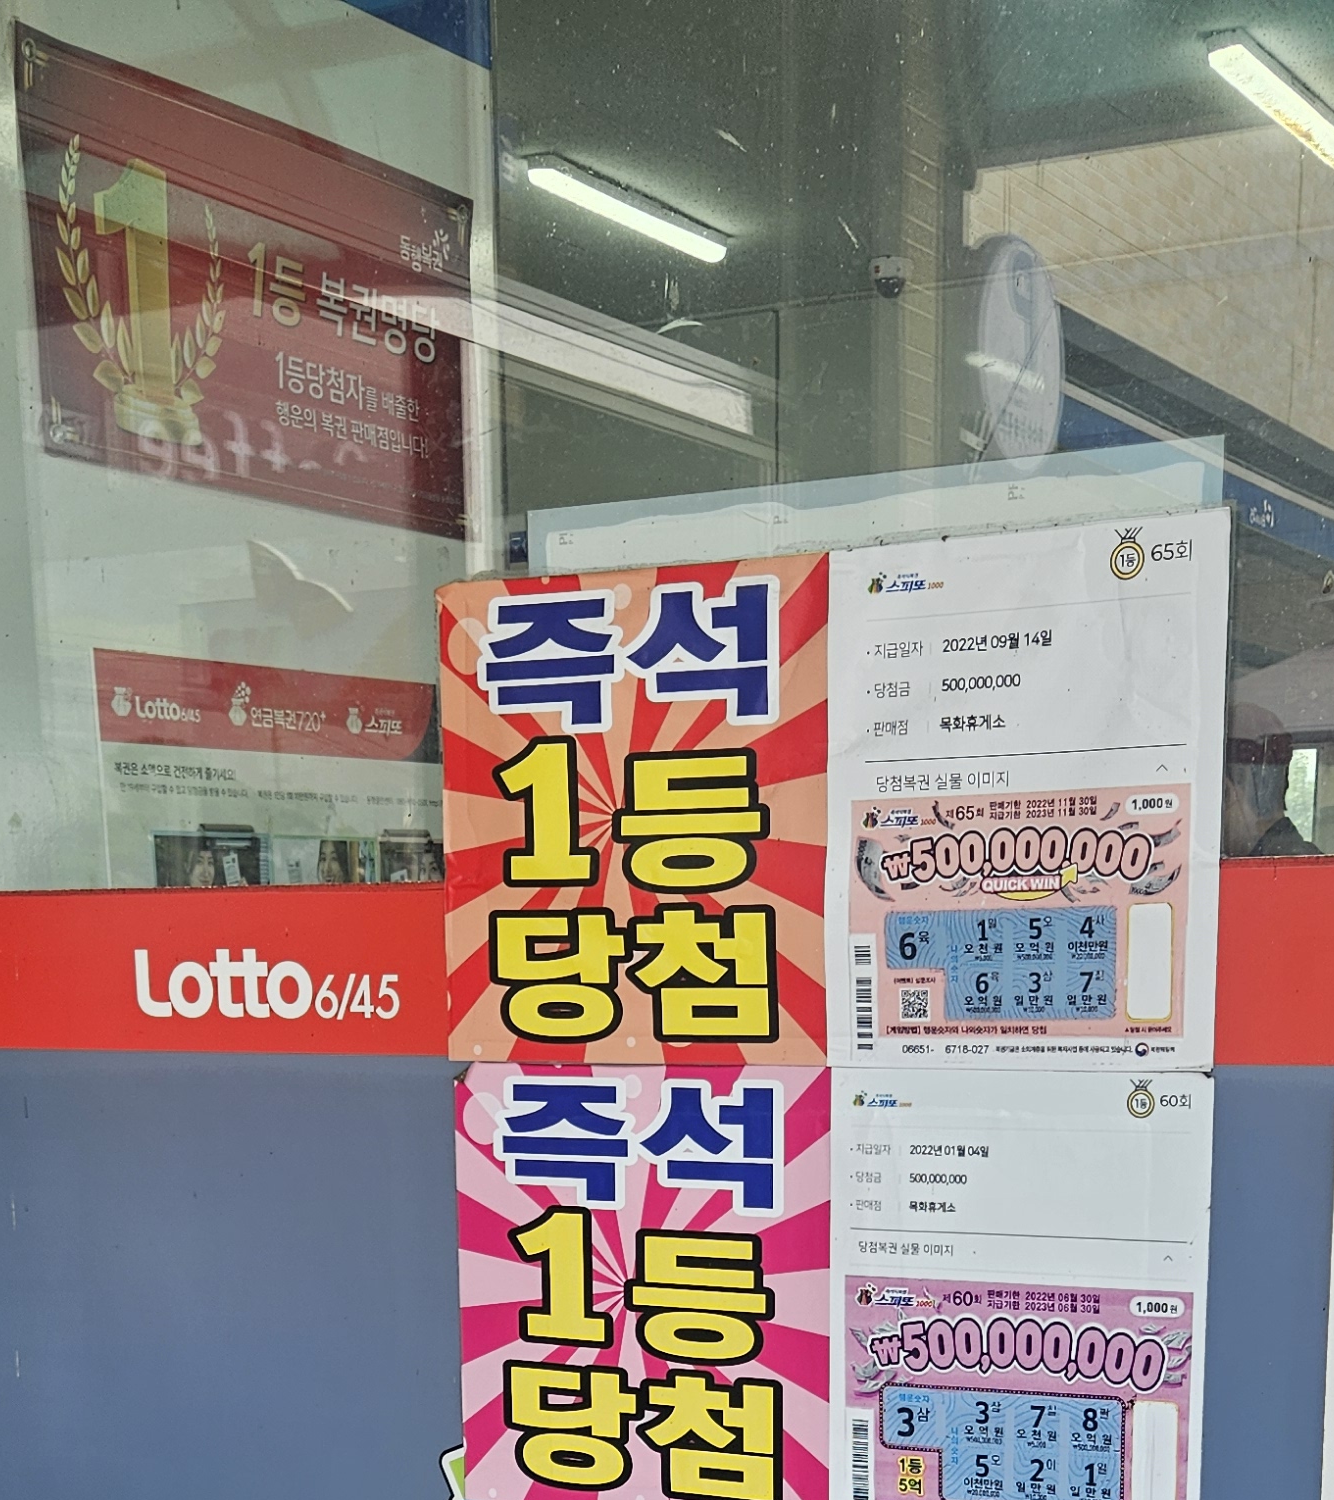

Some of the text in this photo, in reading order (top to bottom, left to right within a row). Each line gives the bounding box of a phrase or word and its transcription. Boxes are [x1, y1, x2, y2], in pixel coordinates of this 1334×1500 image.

[247, 241, 440, 363] 1등 복권명당
[275, 351, 419, 422] 1등당첨자를 배출한
[275, 400, 317, 433] 행운의
[321, 411, 348, 440] 복권
[1120, 539, 1192, 567] 1등 65회
[482, 579, 772, 729] 즉석
[874, 629, 1053, 659] 지급일자 2022년 09월 14일
[874, 673, 1021, 698] 당첨금 500,000,000
[873, 714, 1006, 737] 판매점 목화휴게소
[876, 771, 1009, 793] 당첨복권 실물 이미지
[1026, 799, 1055, 809] 2022년
[1058, 797, 1076, 808] 11월
[1079, 796, 1097, 806] 30일
[1026, 809, 1055, 819] 2023년
[1058, 807, 1076, 818] 11월
[1079, 806, 1097, 816] 30일
[493, 736, 770, 894] 1등
[980, 875, 1062, 893] QUICK WIN
[977, 919, 988, 941] 1
[1029, 918, 1042, 939] 5
[1080, 916, 1094, 938] 4
[899, 932, 917, 960] 6
[489, 902, 779, 1044] 당첨
[976, 971, 1094, 994] 6 3 7
[945, 1045, 989, 1054] 6718-027
[1160, 1094, 1191, 1109] 60회
[500, 1081, 776, 1212] 즉석
[856, 1143, 989, 1158] 지급일자 2022년 01월 04일
[909, 1173, 967, 1185] 500,000,000
[909, 1201, 956, 1213] 목화휴게소
[858, 1241, 898, 1254] 당첨복권
[923, 1244, 954, 1257] 이미지
[507, 1205, 775, 1366] 1등
[1024, 1301, 1055, 1312] 2023년
[1058, 1303, 1077, 1313] 06월
[1080, 1304, 1100, 1314] 30일
[1025, 1292, 1055, 1302] 2022년
[1058, 1293, 1077, 1303] 06월
[1080, 1294, 1100, 1304] 30일
[897, 1407, 915, 1437] 3
[975, 1401, 989, 1424] 3
[1030, 1405, 1046, 1428] 7
[1082, 1408, 1098, 1432] 8
[899, 1458, 922, 1474] 1등
[975, 1454, 1097, 1487] 5 2 1
[899, 1478, 922, 1494] 5억
